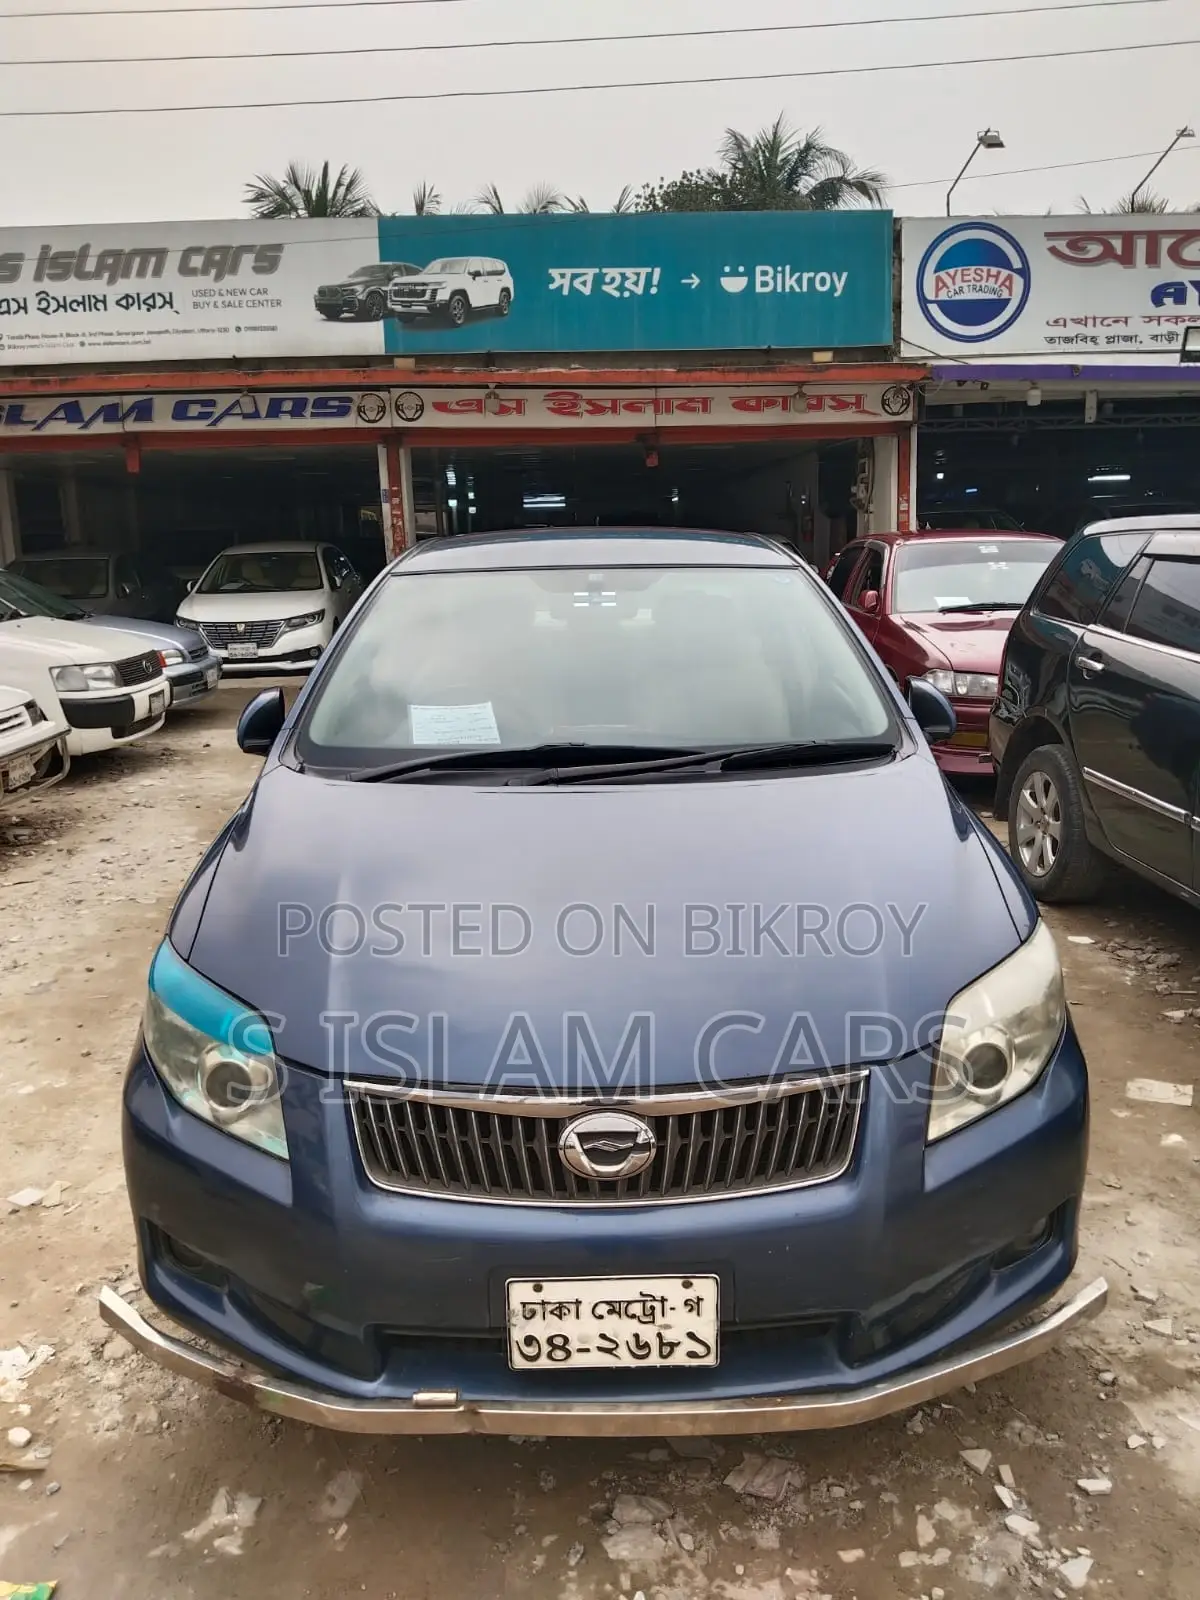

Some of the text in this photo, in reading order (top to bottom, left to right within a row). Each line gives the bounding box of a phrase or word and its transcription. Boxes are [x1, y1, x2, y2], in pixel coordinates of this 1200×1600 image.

[191, 287, 269, 298] USED & NEW CAR
[548, 267, 600, 296] সব
[754, 264, 849, 297] Bikroy
[934, 267, 1014, 299] AYESHA
[946, 284, 1004, 299] CAR TRADING
[35, 290, 108, 315] ইসলাম
[192, 299, 282, 310] BUY & SALE CENTER
[1045, 314, 1131, 328] এখানে
[0, 396, 354, 431] LAM CARS
[520, 1298, 582, 1321] ঢাকা
[516, 1331, 712, 1362] ৩৪-২৬৮১
